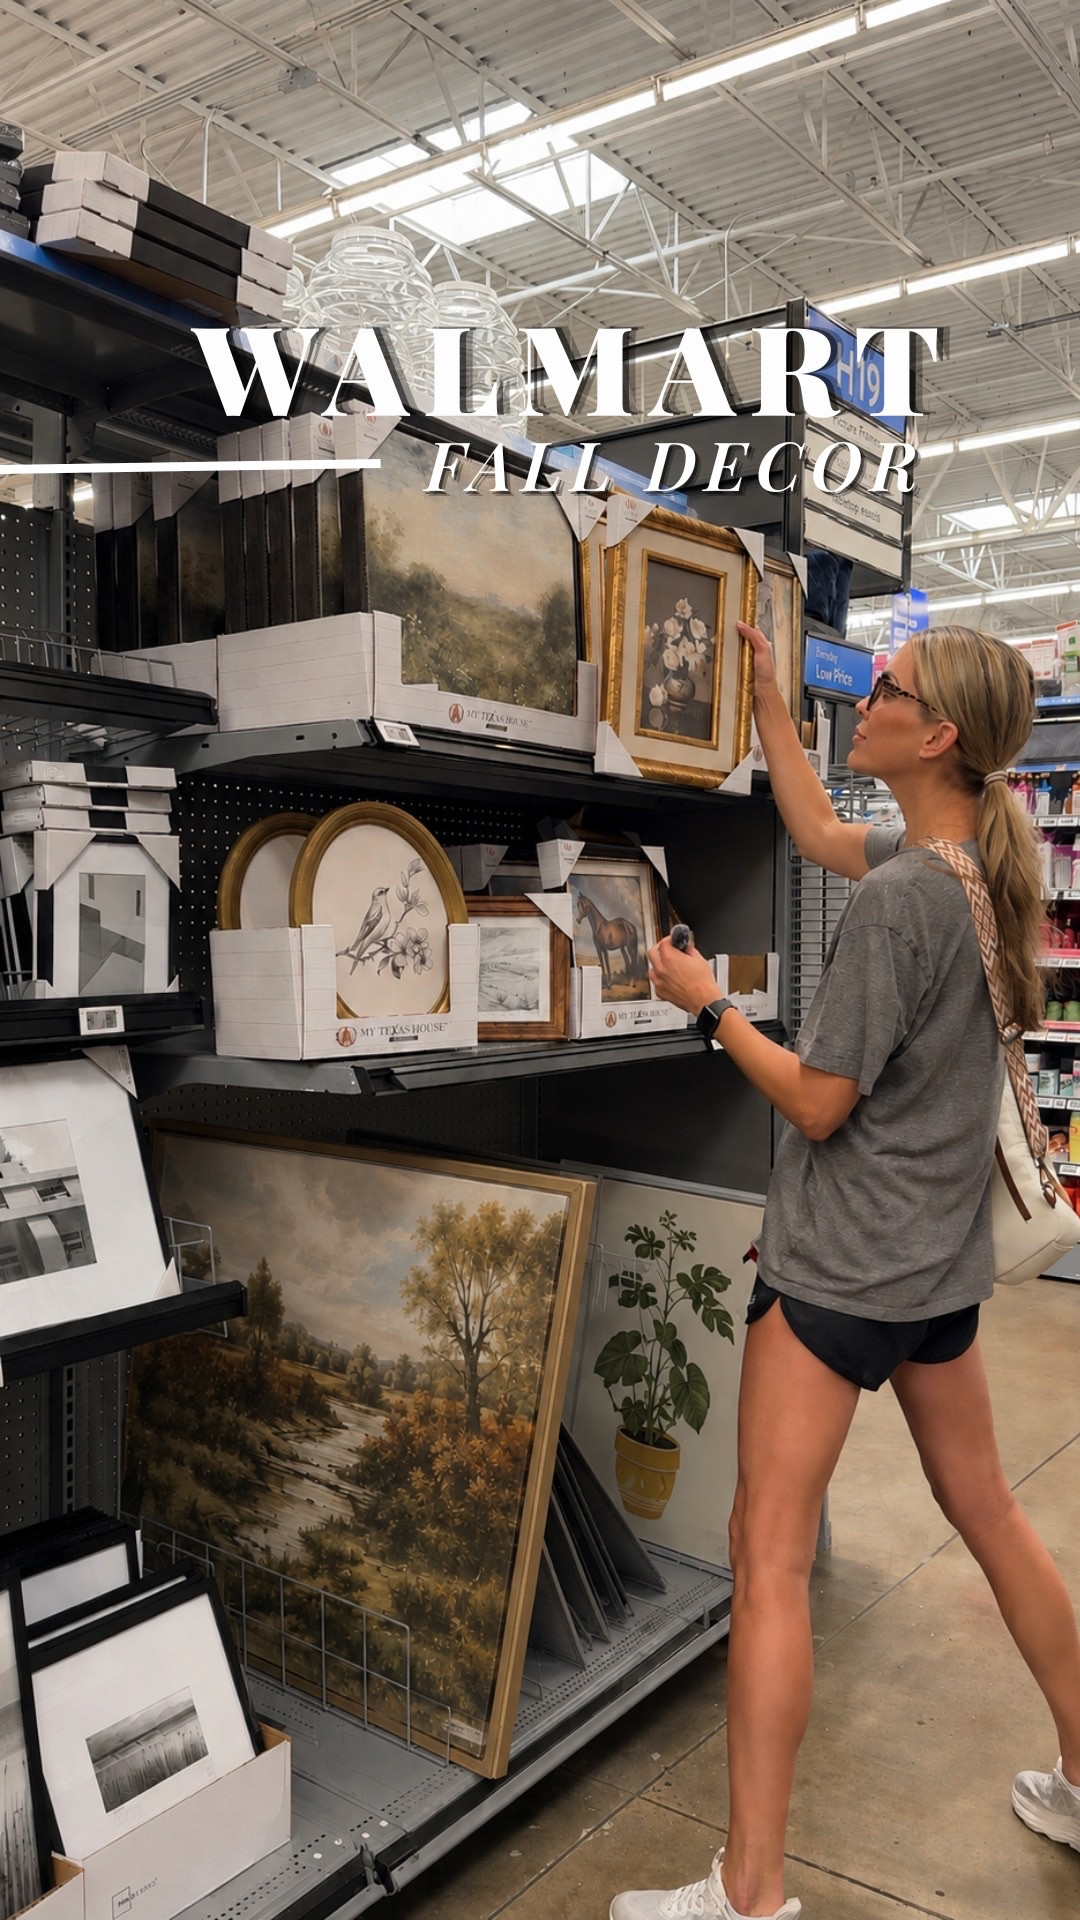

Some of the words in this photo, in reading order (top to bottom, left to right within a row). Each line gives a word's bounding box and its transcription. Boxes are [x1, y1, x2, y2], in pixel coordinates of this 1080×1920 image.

[836, 341, 881, 407] H19
[815, 663, 833, 682] Low
[833, 667, 853, 686] Price
[360, 1027, 376, 1038] MY
[379, 1023, 410, 1036] TEXAS
[411, 1021, 448, 1035] HOUSE
